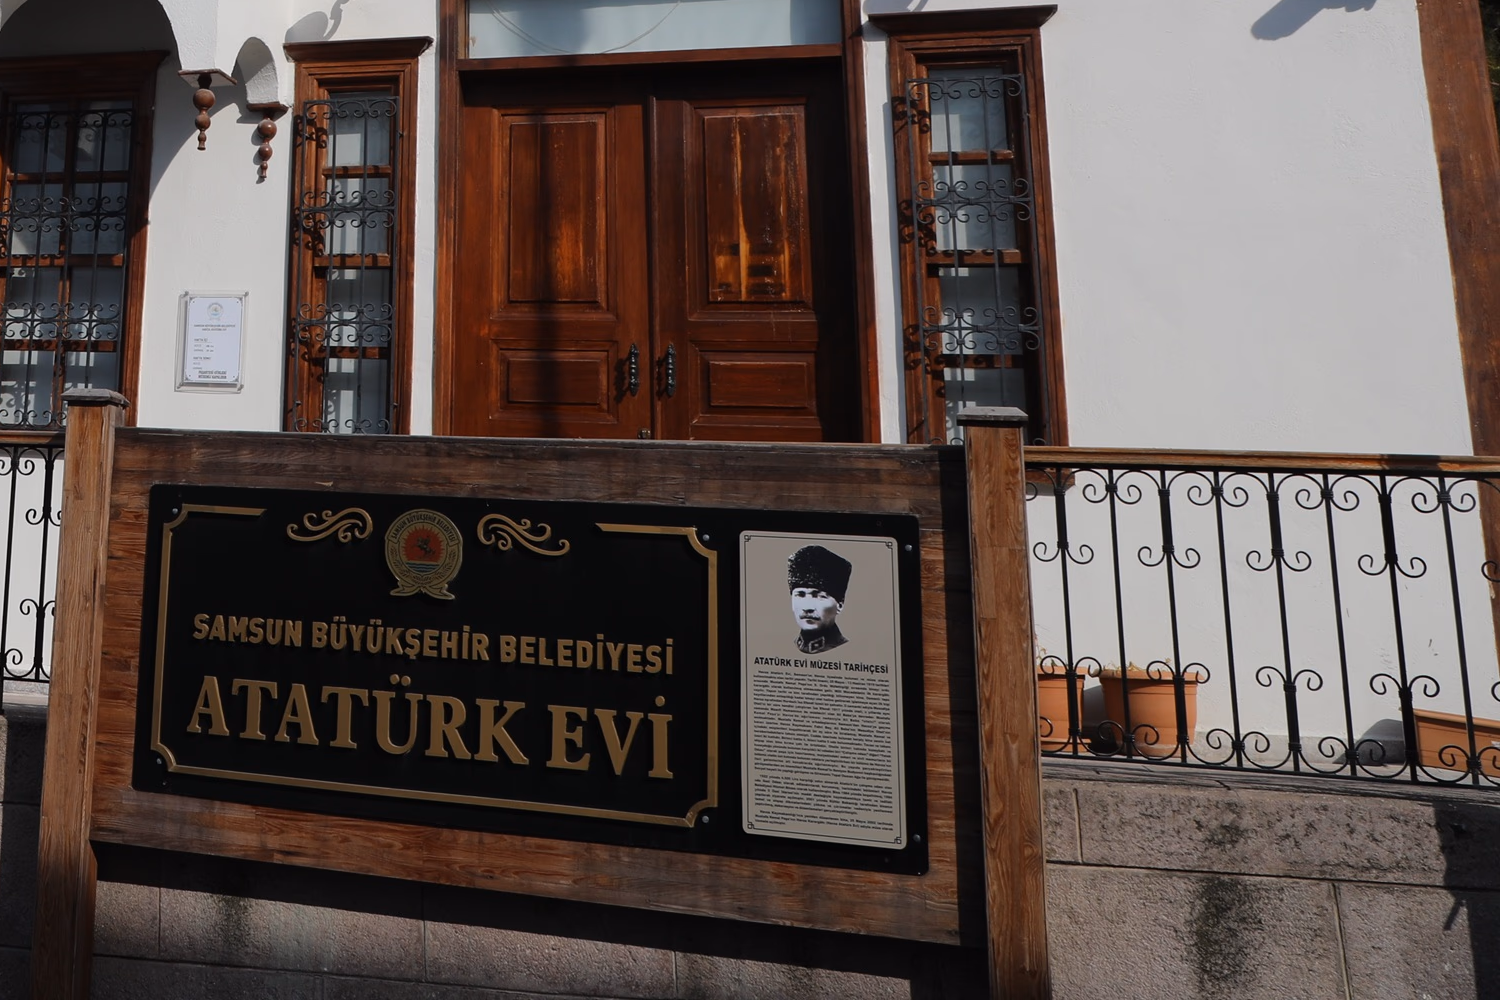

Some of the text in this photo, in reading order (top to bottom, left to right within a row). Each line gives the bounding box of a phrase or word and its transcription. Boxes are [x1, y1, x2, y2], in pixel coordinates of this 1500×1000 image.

[192, 613, 674, 675] SAMSUN BÜYÜKŞEHİR BELEDİYESİ
[753, 656, 889, 674] ATATÜRK EVİ MÜZESİ TARİHÇESİ
[186, 673, 530, 765] ATATÜRK
[546, 695, 674, 779] EVİ
